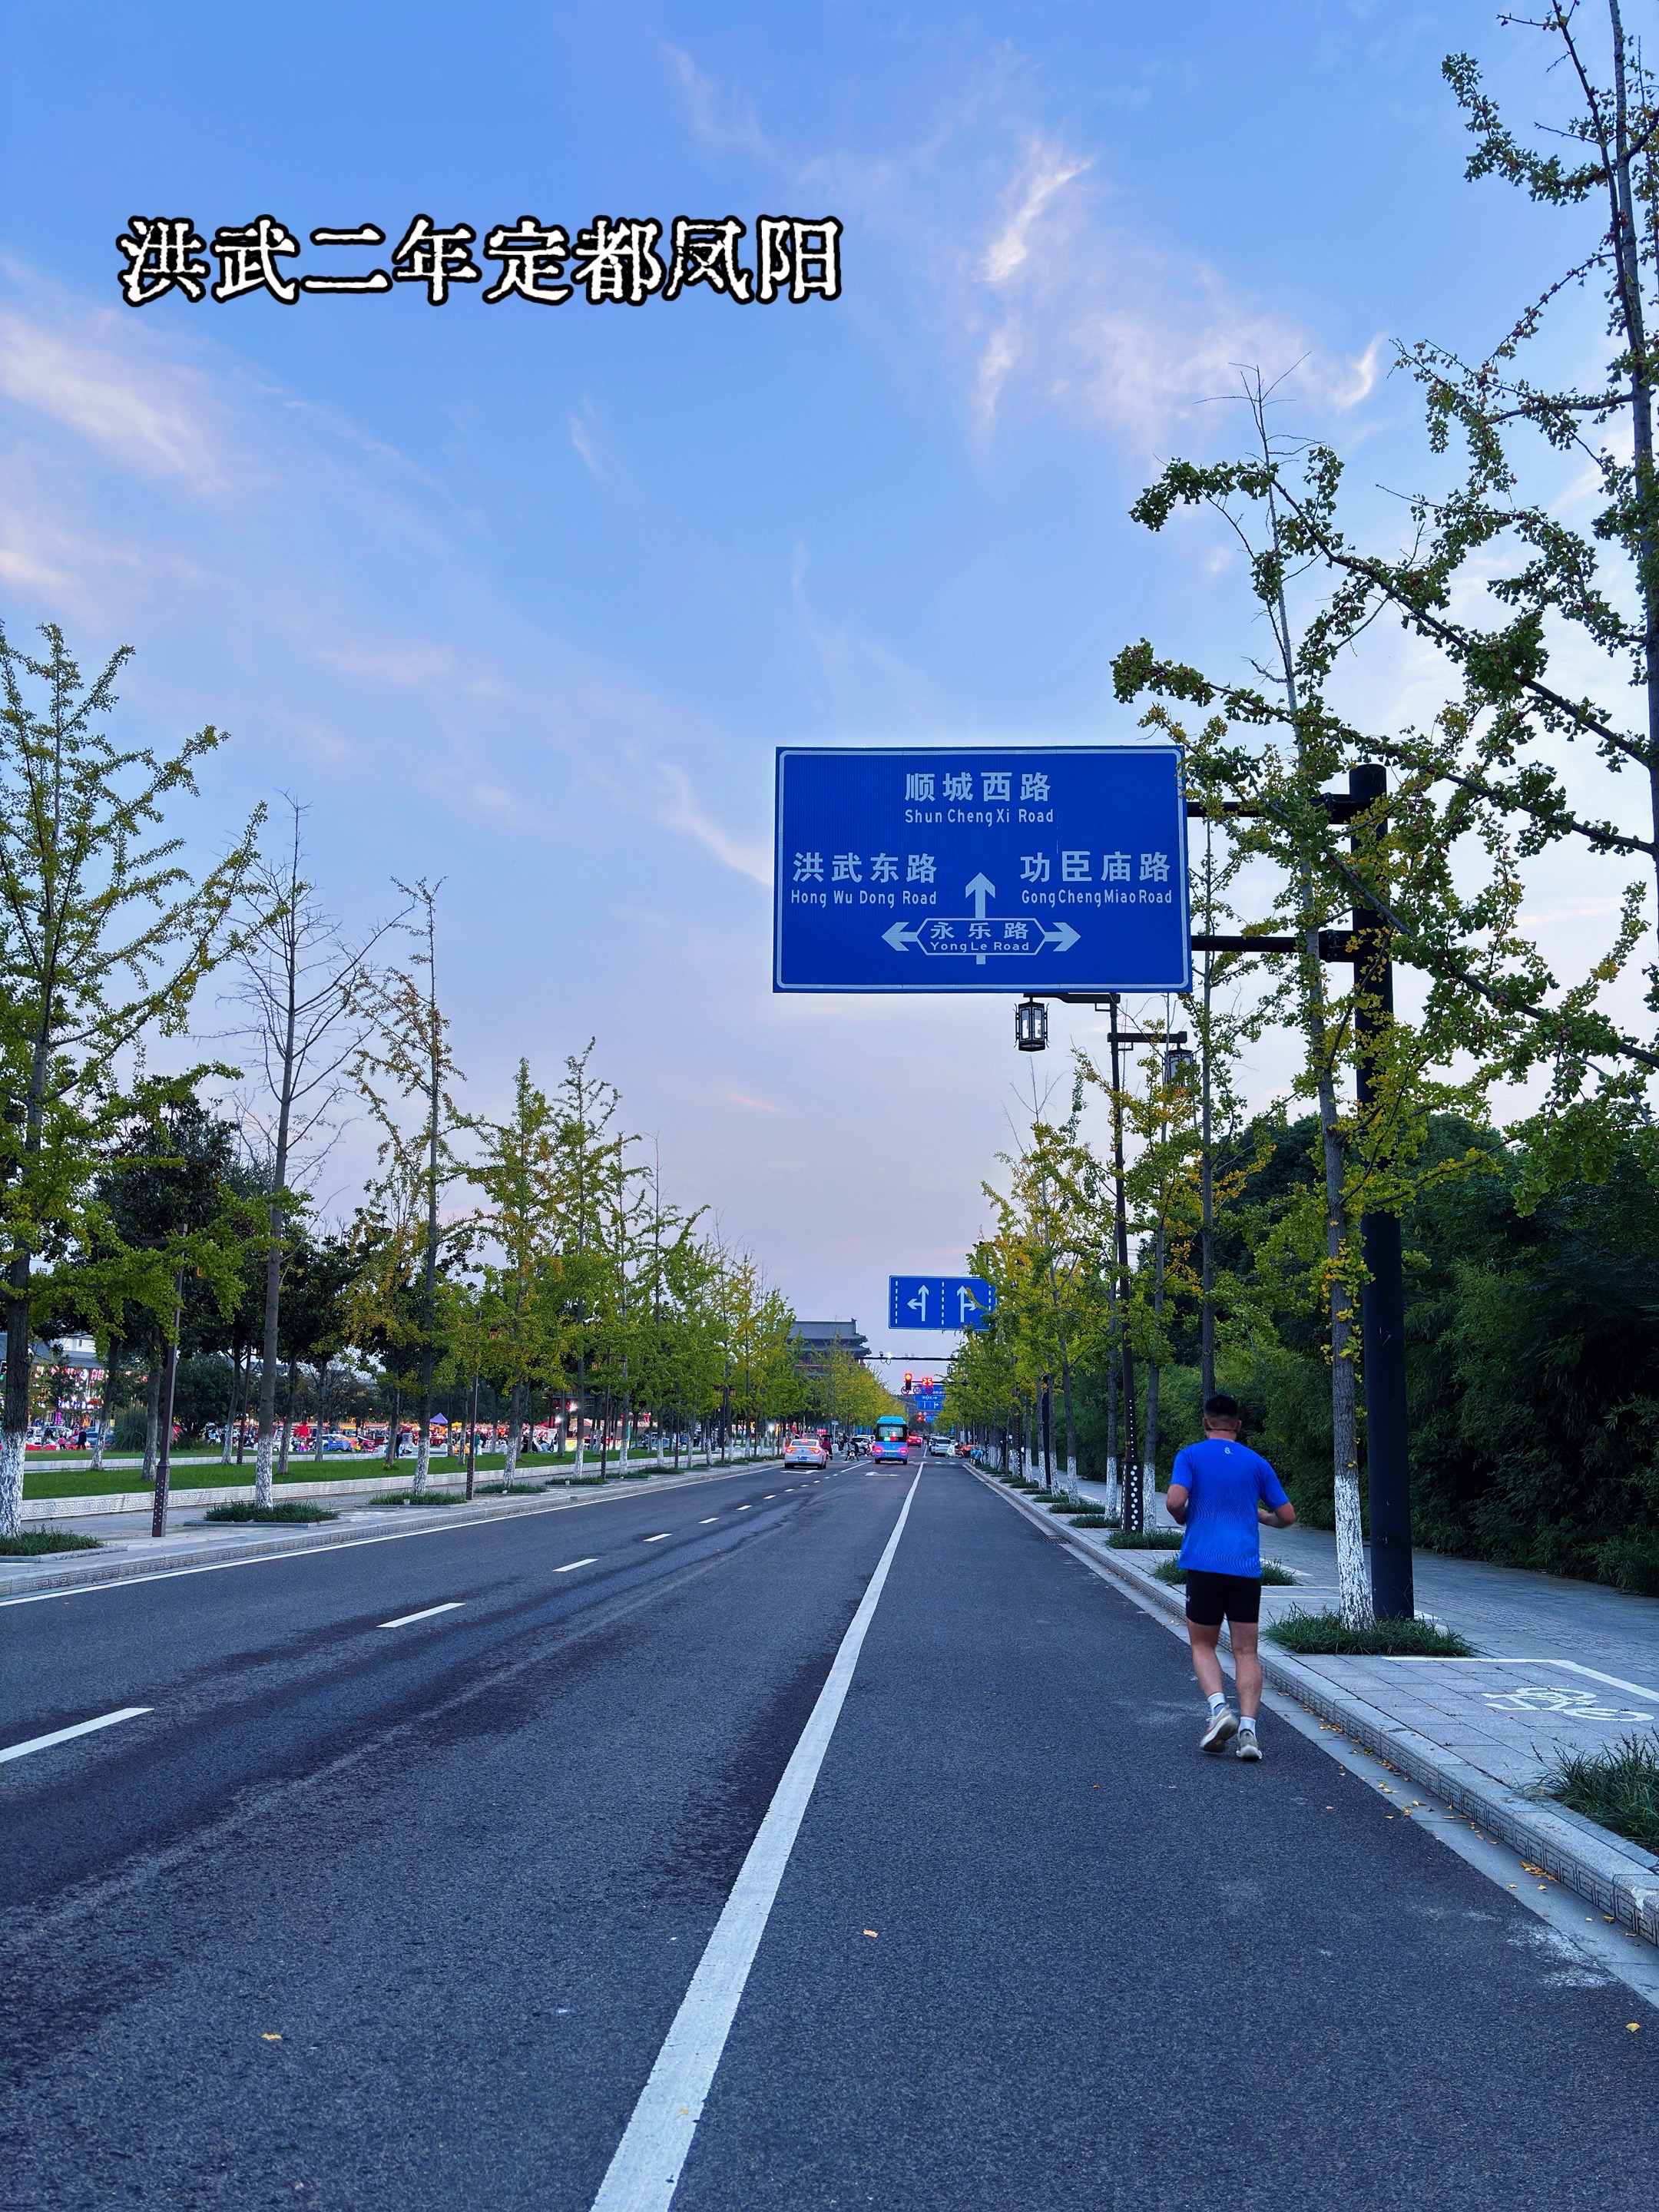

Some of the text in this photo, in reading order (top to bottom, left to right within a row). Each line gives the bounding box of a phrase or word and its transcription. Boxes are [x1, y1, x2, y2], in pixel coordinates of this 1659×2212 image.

[905, 772, 1051, 802] 顺城西路
[905, 809, 942, 823] Shun
[1018, 809, 1054, 823] Road
[793, 852, 937, 883] 洪武东路
[1020, 850, 1171, 882] 功臣庙路
[791, 890, 936, 908] Hong Wu Dong Road
[930, 922, 1029, 939] 永乐路
[994, 942, 1029, 952] Road
